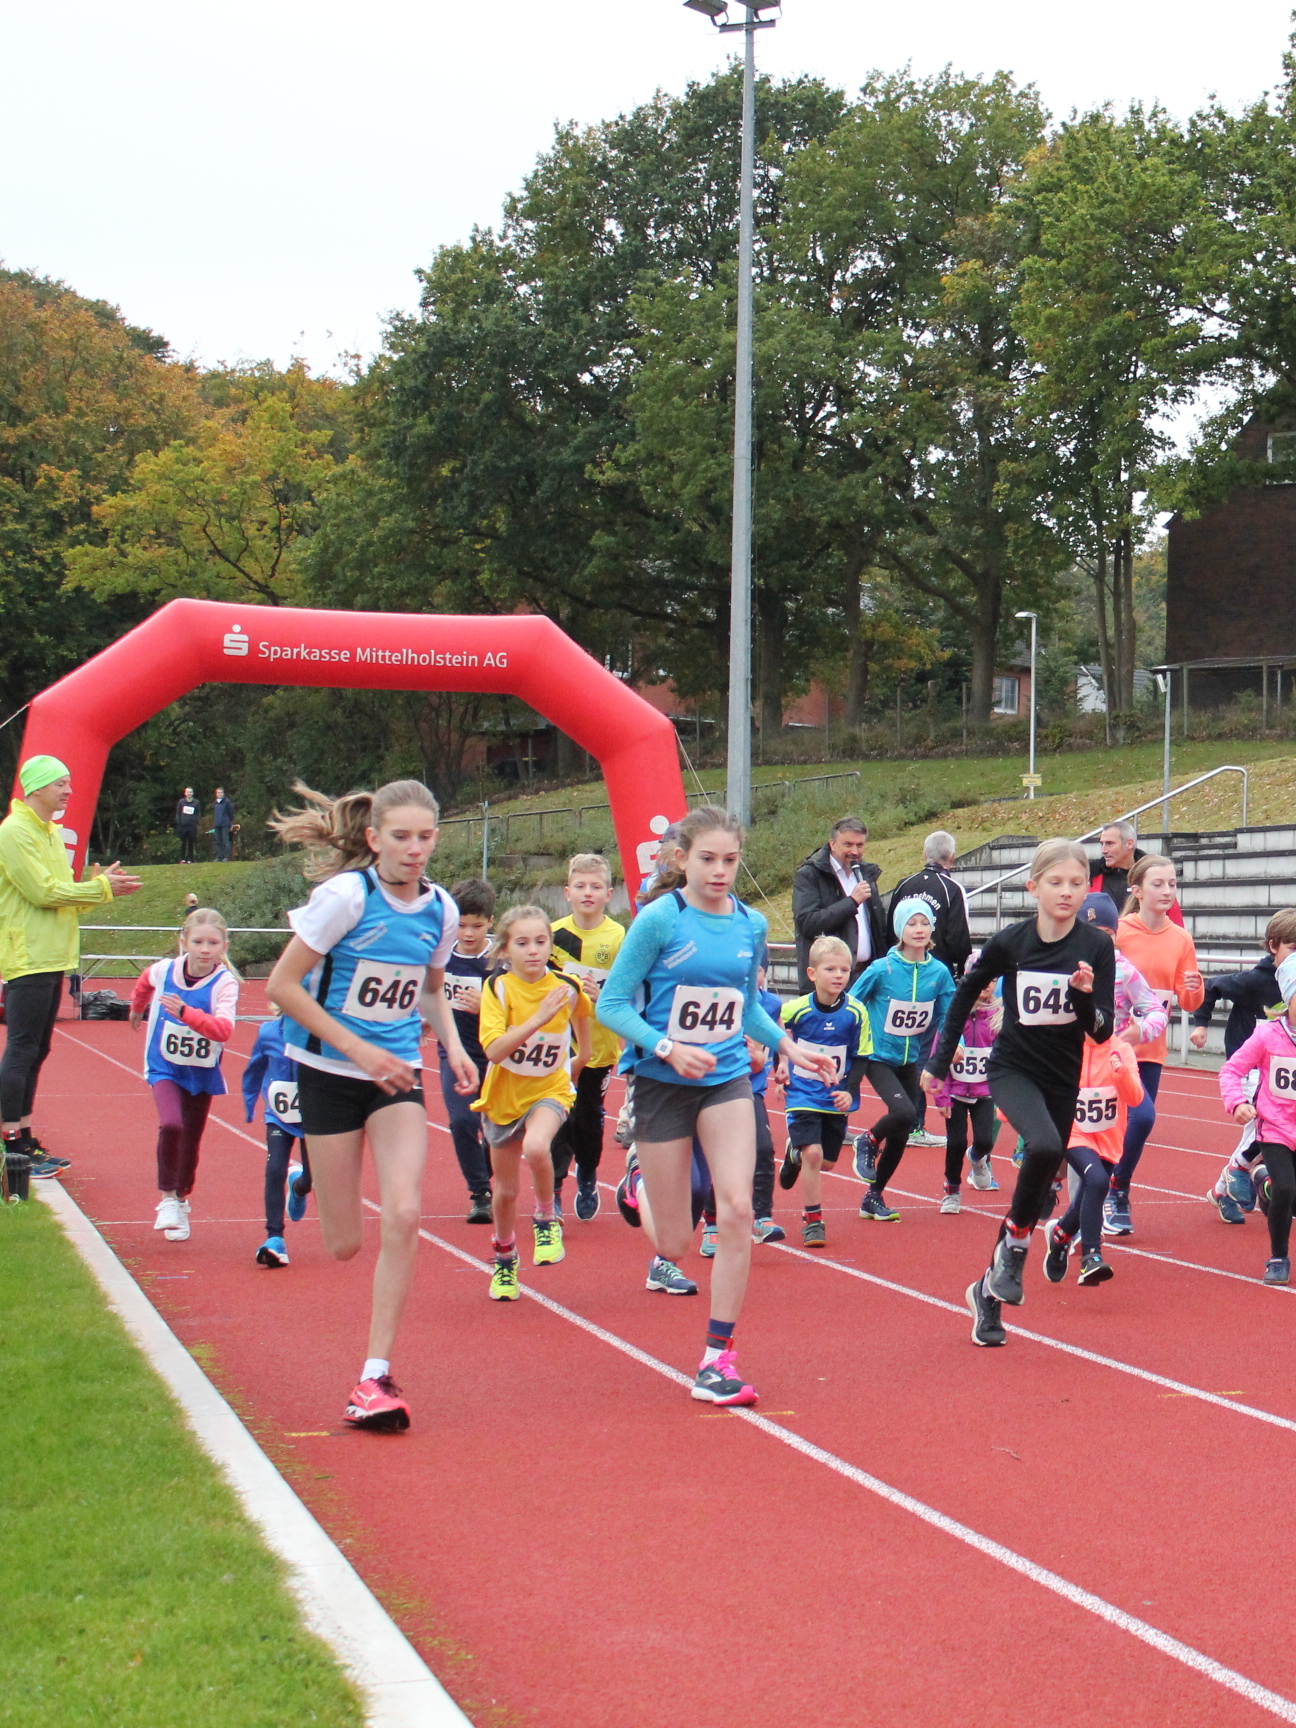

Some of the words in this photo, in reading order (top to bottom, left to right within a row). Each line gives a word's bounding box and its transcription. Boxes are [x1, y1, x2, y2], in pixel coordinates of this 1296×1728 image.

[258, 641, 350, 662] Sparkasse
[355, 647, 479, 668] Mittelholstein
[483, 652, 508, 668] AG
[357, 976, 418, 1010] 646
[678, 1000, 736, 1031] 644
[891, 1009, 929, 1029] 652
[166, 1033, 211, 1059] 658
[510, 1042, 561, 1068] 645
[953, 1056, 988, 1075] 653
[1075, 1097, 1118, 1123] 655
